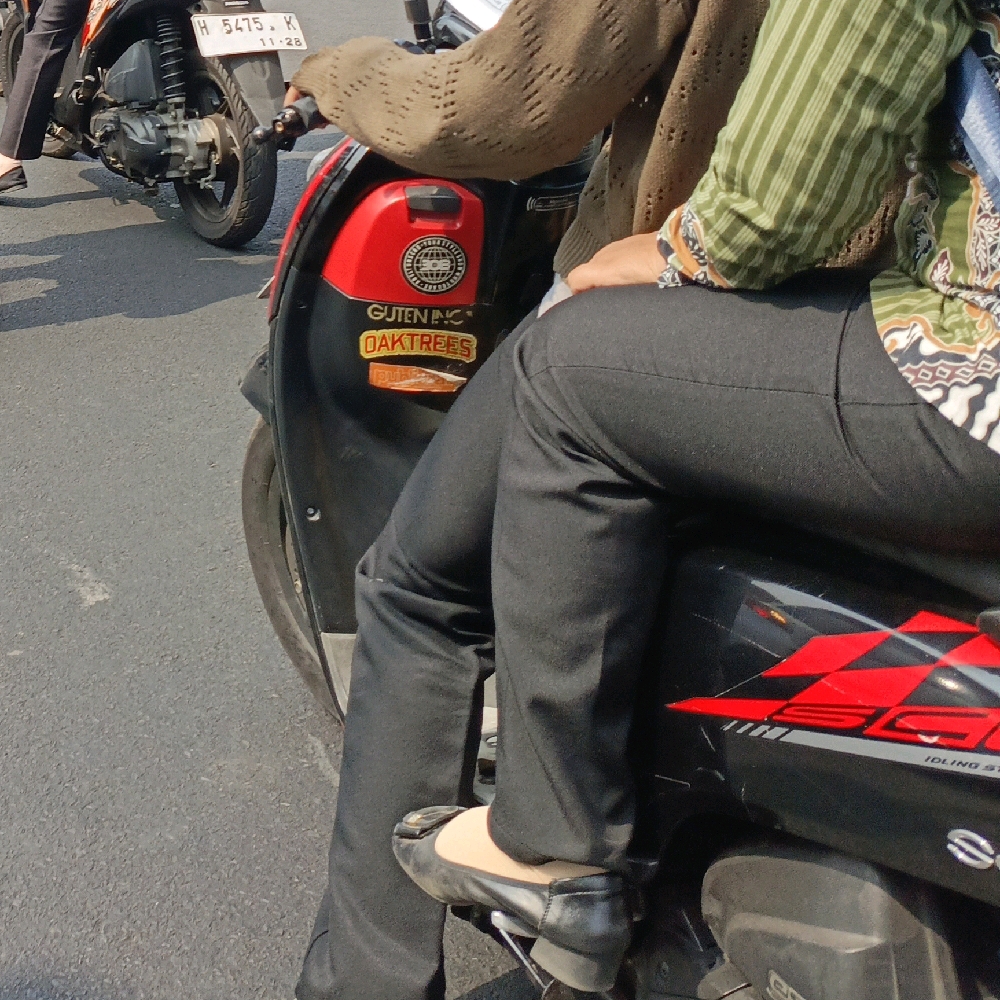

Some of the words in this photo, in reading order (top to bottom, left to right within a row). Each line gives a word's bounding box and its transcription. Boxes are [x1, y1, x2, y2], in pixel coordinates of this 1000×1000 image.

[196, 18, 210, 36] H
[221, 16, 264, 35] 5475
[284, 15, 297, 31] K
[366, 303, 429, 325] GUTEN
[364, 332, 473, 359] OAKTREES
[924, 754, 980, 770] IDLING
